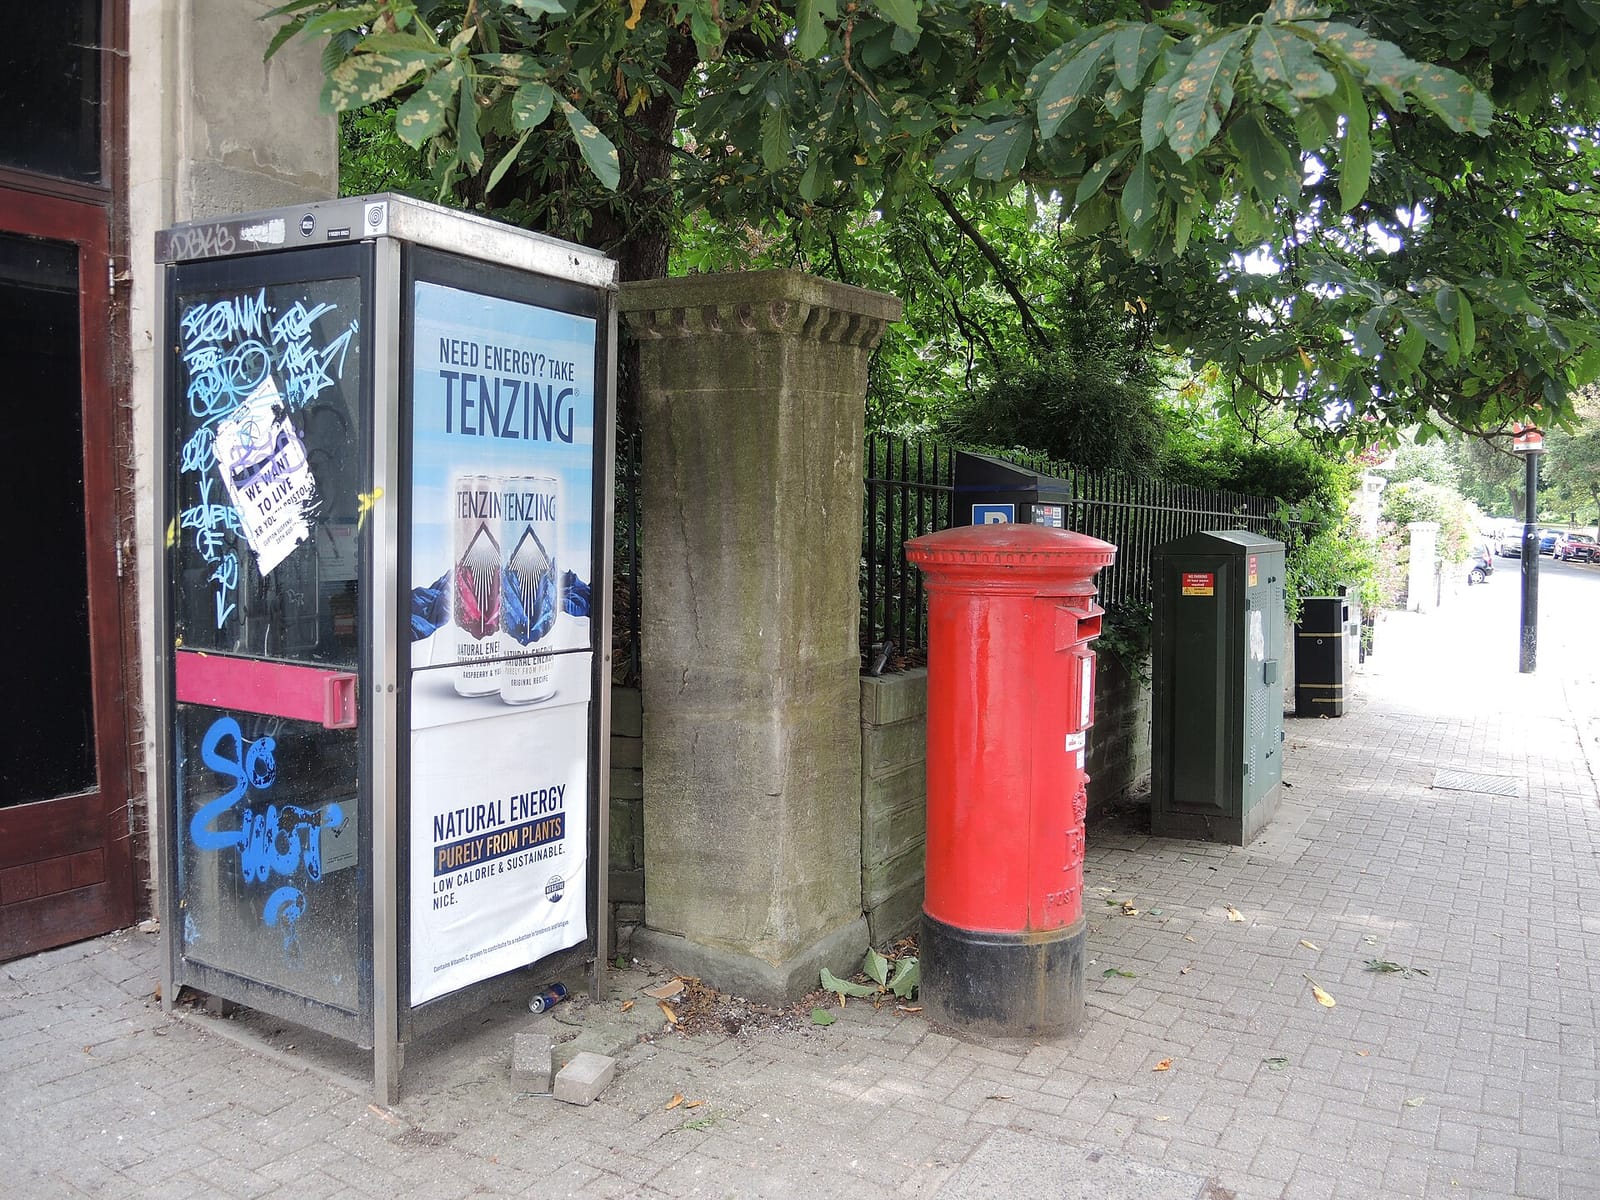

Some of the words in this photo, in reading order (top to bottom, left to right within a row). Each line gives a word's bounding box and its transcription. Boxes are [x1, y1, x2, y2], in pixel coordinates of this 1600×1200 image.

[440, 337, 479, 368] NEED
[484, 345, 546, 377] ENERGY?
[548, 359, 575, 382] TAKE
[440, 370, 574, 444] TENZING
[245, 481, 262, 502] WE
[261, 453, 290, 486] WANT
[258, 497, 272, 516] TO
[272, 477, 294, 503] LIVE
[504, 493, 556, 522] TENZING
[254, 525, 264, 538] XR
[458, 643, 483, 656] NATURAL
[463, 671, 489, 679] RASPBERRY
[511, 678, 532, 687] ORIGINAL
[433, 799, 506, 843] NATURAL
[510, 783, 566, 822] ENERGY
[438, 838, 484, 871] PURELY
[486, 829, 519, 857] FROM
[521, 817, 562, 847] PLANTS
[433, 876, 454, 894] LOW
[456, 863, 496, 887] CALORIE
[498, 861, 504, 874] &
[506, 843, 566, 871] SUSTAINABLE.
[433, 892, 458, 911] NICE.
